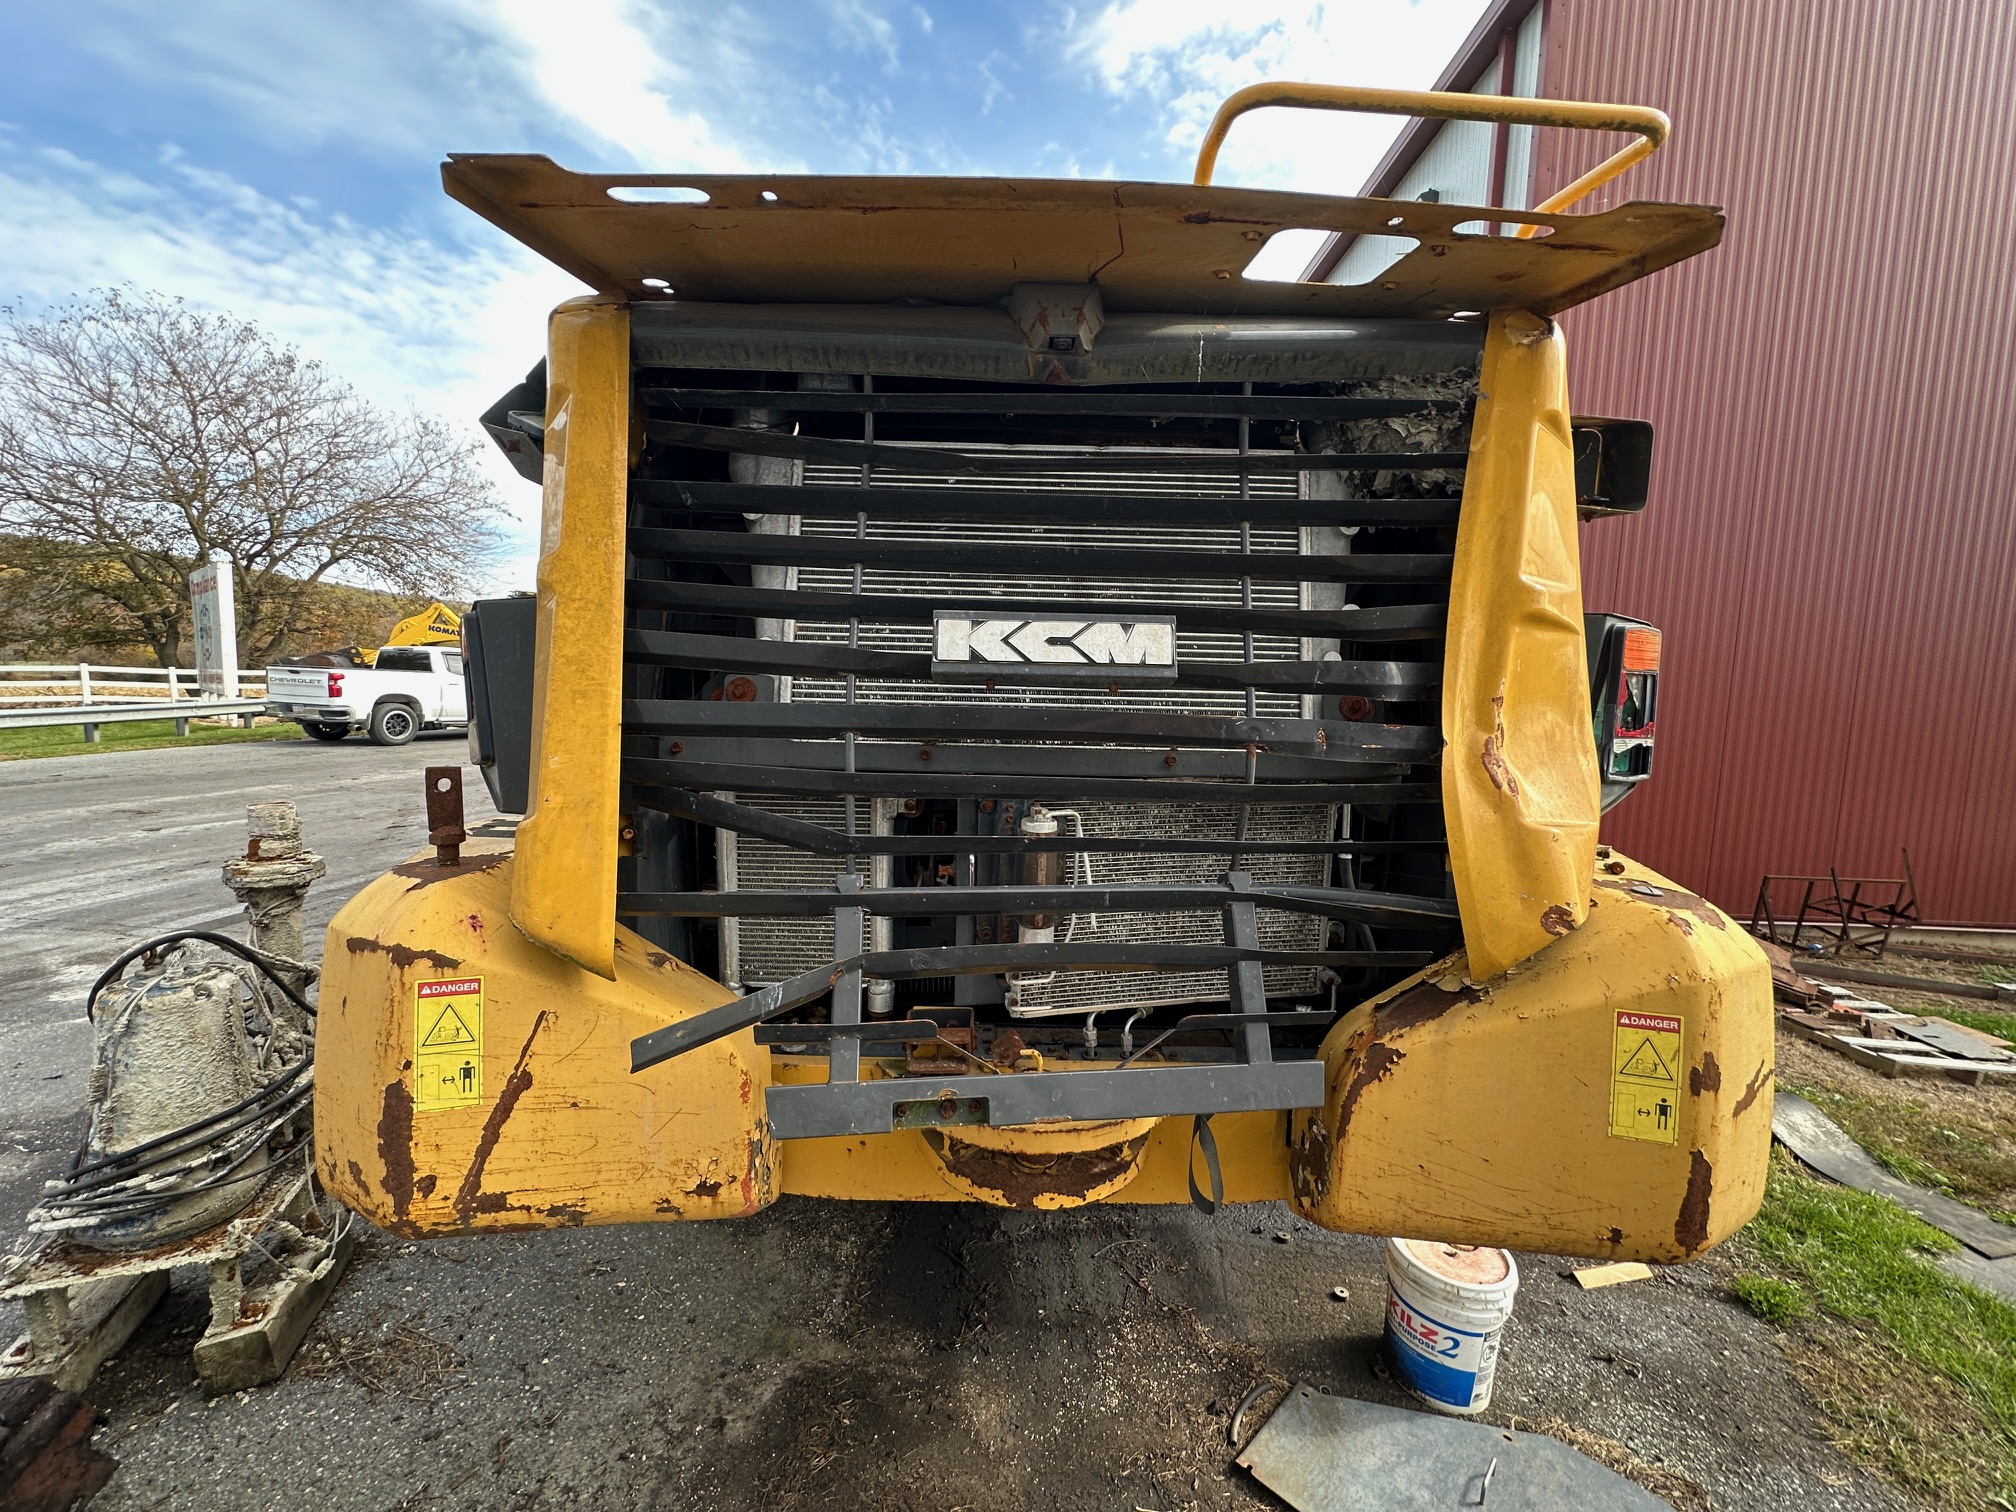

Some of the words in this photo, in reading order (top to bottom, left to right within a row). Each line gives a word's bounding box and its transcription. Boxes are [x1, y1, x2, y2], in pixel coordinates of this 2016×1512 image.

[936, 619, 1174, 665] KCM
[432, 982, 478, 993] DANGER
[1631, 1016, 1678, 1029] DANGER
[1389, 1295, 1439, 1345] KILZ
[1437, 1336, 1460, 1360] 2
